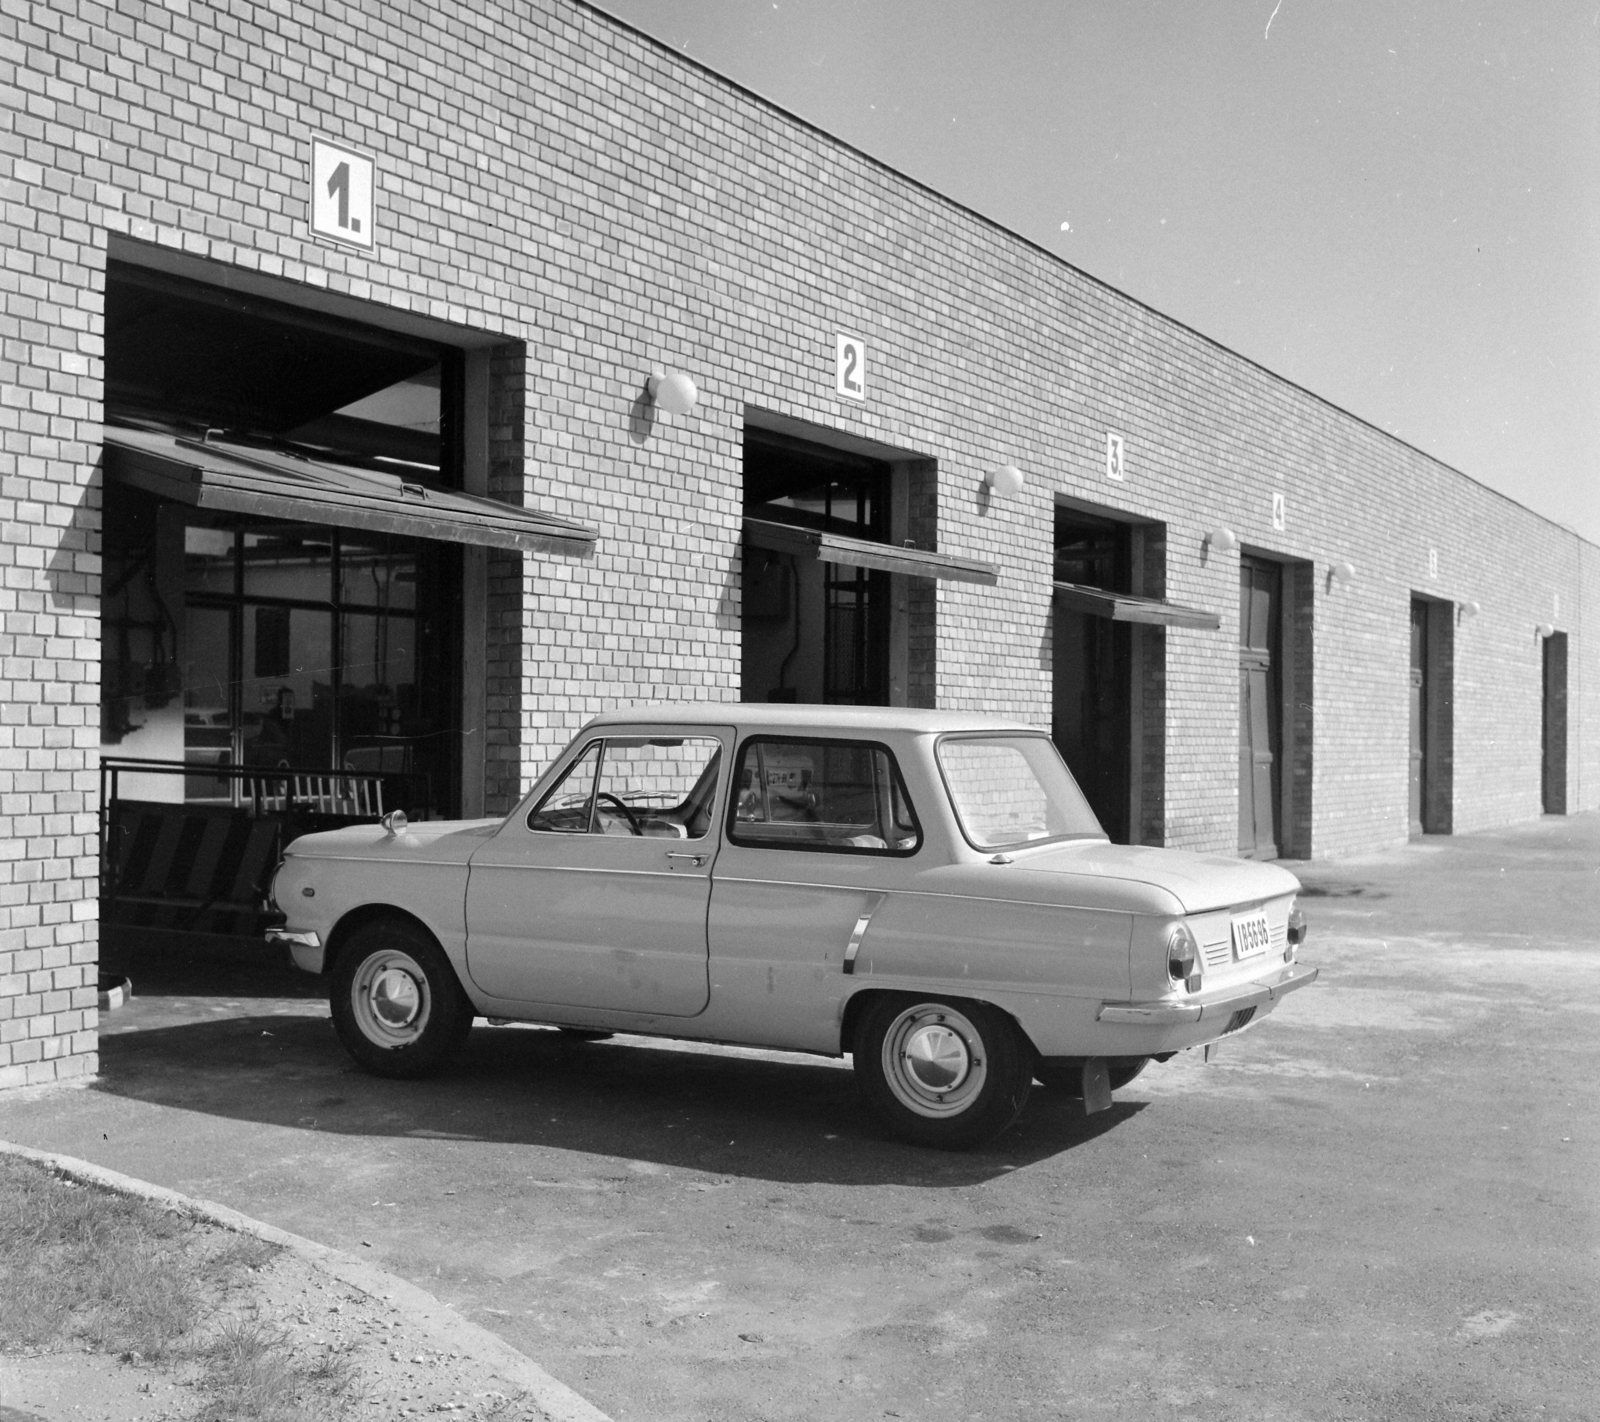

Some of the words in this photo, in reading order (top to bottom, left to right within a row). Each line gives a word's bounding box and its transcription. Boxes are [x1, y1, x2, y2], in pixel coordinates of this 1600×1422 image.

[327, 161, 361, 233] 1.
[844, 343, 861, 393] 2.
[1111, 439, 1121, 476] 3.
